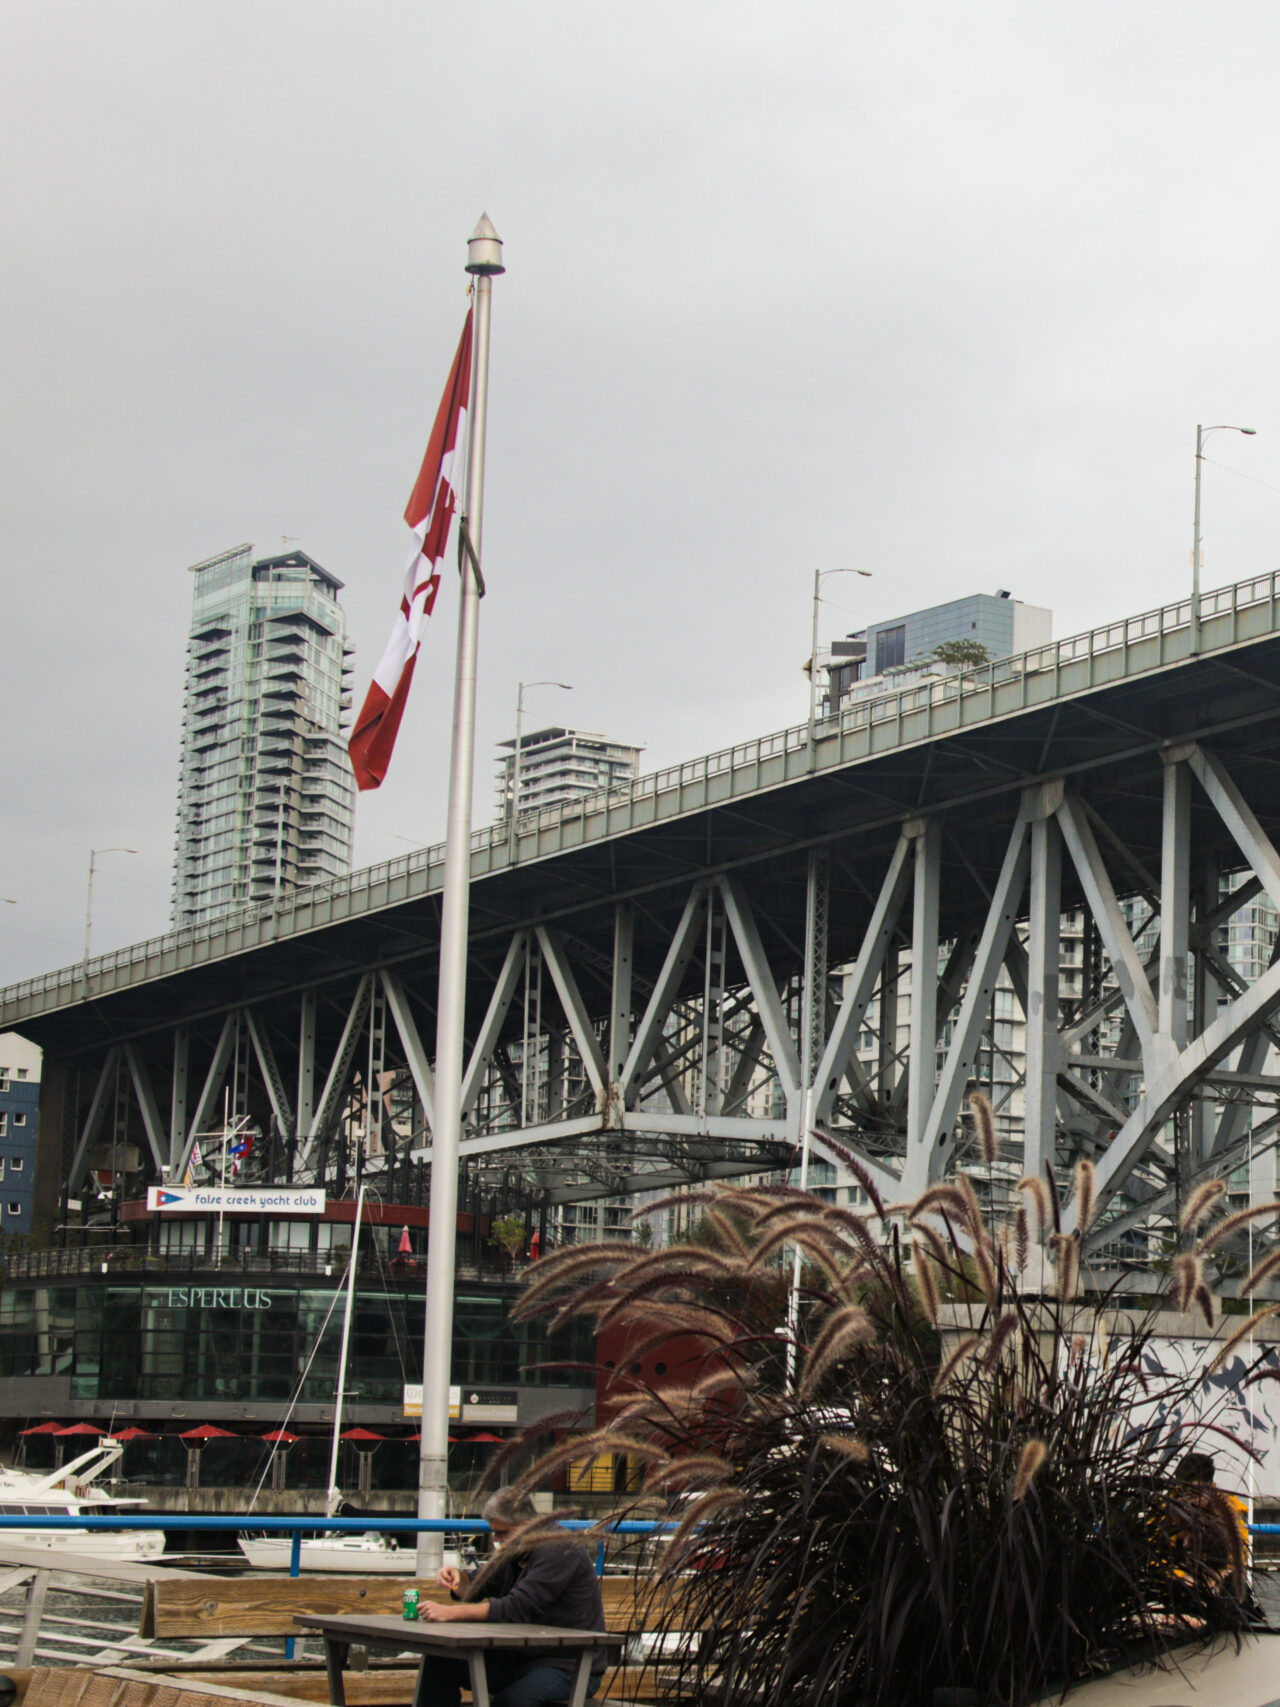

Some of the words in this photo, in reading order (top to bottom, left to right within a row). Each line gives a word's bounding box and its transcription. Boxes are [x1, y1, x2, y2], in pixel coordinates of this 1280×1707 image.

[195, 1193, 222, 1205] false
[226, 1194, 256, 1205] creek
[260, 1195, 290, 1209] yacht
[294, 1195, 317, 1206] club
